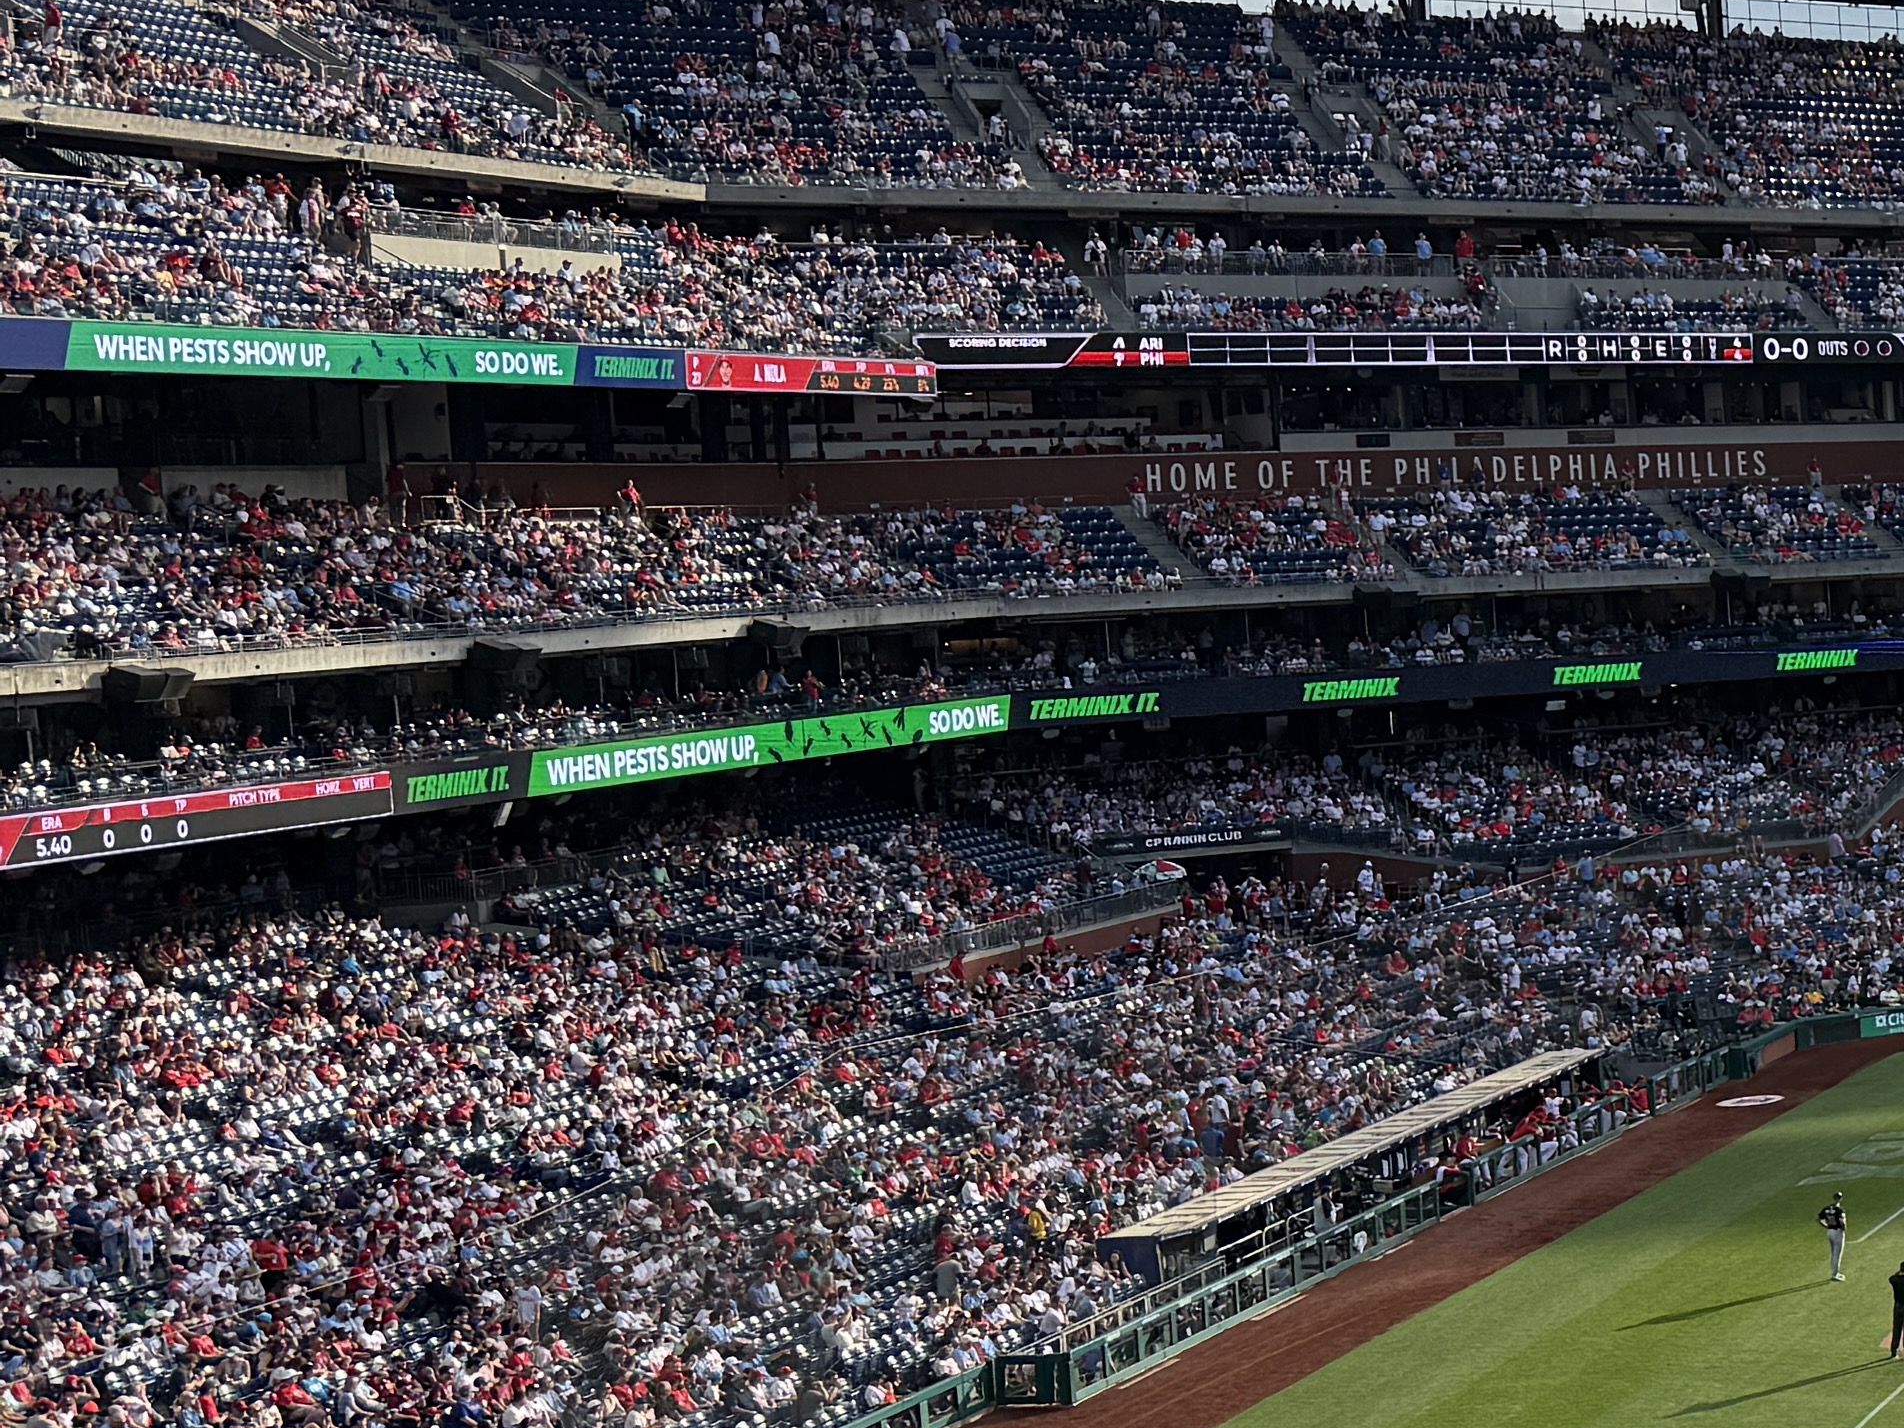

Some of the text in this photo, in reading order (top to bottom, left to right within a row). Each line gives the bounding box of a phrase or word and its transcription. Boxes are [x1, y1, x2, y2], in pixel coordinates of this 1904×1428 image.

[94, 333, 331, 372] WHEN PESTS SHOW UP,
[949, 337, 1047, 348] SCORING DECISION
[1139, 337, 1163, 351] ARI
[1550, 340, 1667, 357] R H E
[1763, 337, 1848, 360] 0-0 OUTS
[475, 351, 563, 376] SO DO WE.
[594, 355, 675, 380] TERMINIX IT.
[1140, 352, 1164, 366] PHI
[764, 363, 787, 383] NOLA
[1145, 461, 1237, 492] HOME
[1258, 459, 1294, 489] OF
[1315, 458, 1372, 487] THE
[1638, 450, 1767, 479] PHILLIES
[1776, 649, 1858, 671] TERMINIX
[1553, 662, 1643, 685] TERMINIX
[1302, 677, 1400, 703] TERMINIX
[1029, 692, 1160, 720] TERMINIX IT.
[929, 703, 1004, 735] SO DO WE.
[546, 734, 760, 786] WHEN PESTS SHOW UP,
[407, 765, 510, 804] TERMINIX IT.
[41, 816, 63, 831] ERA
[229, 791, 257, 806] PITCH
[258, 787, 281, 803] TYPE
[315, 780, 341, 796] HORZ
[353, 777, 375, 791] VERT
[36, 819, 189, 858] 5.40 0 0 0
[1145, 837, 1163, 848] CP
[1208, 830, 1243, 843] CLUB
